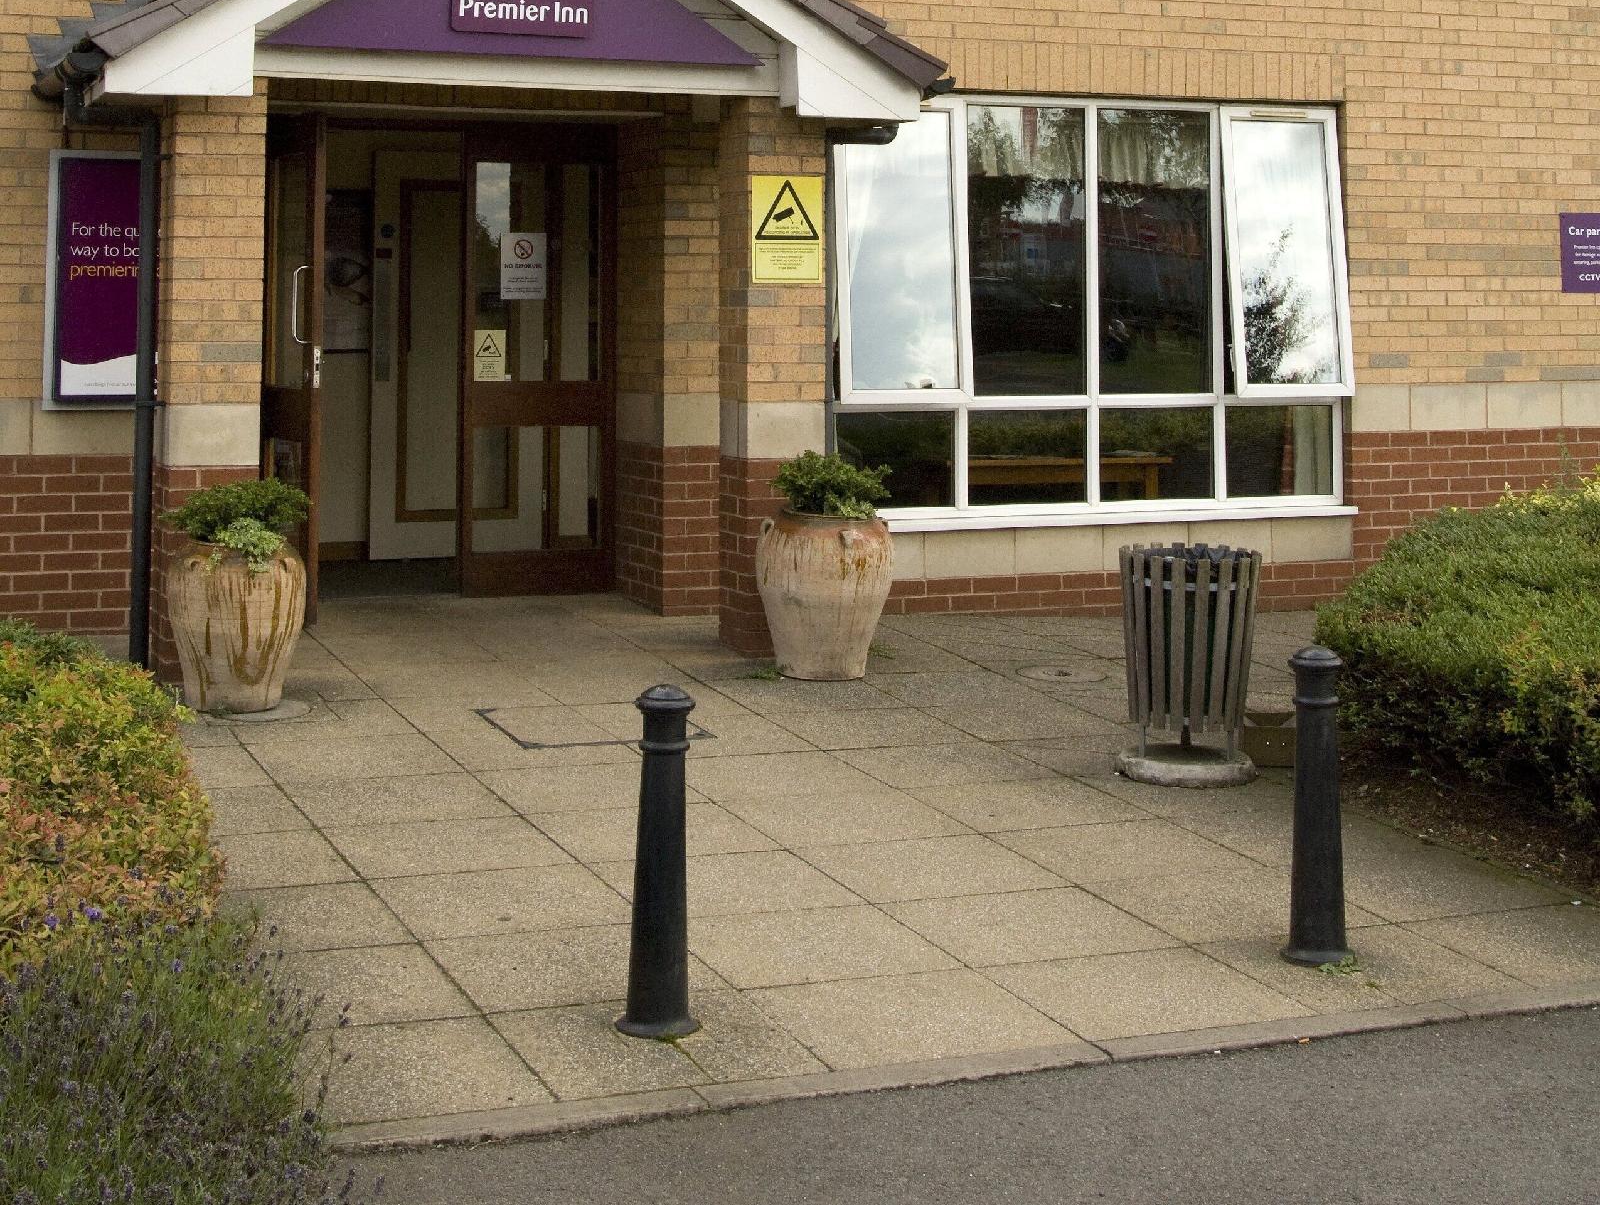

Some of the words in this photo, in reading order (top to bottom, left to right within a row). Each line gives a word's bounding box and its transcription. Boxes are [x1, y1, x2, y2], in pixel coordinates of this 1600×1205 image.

[554, 1, 588, 24] Inn
[71, 221, 95, 236] For
[99, 223, 120, 237] the
[1568, 226, 1584, 236] Car
[70, 245, 99, 260] way
[104, 244, 119, 256] to
[1579, 273, 1600, 281] CCTV
